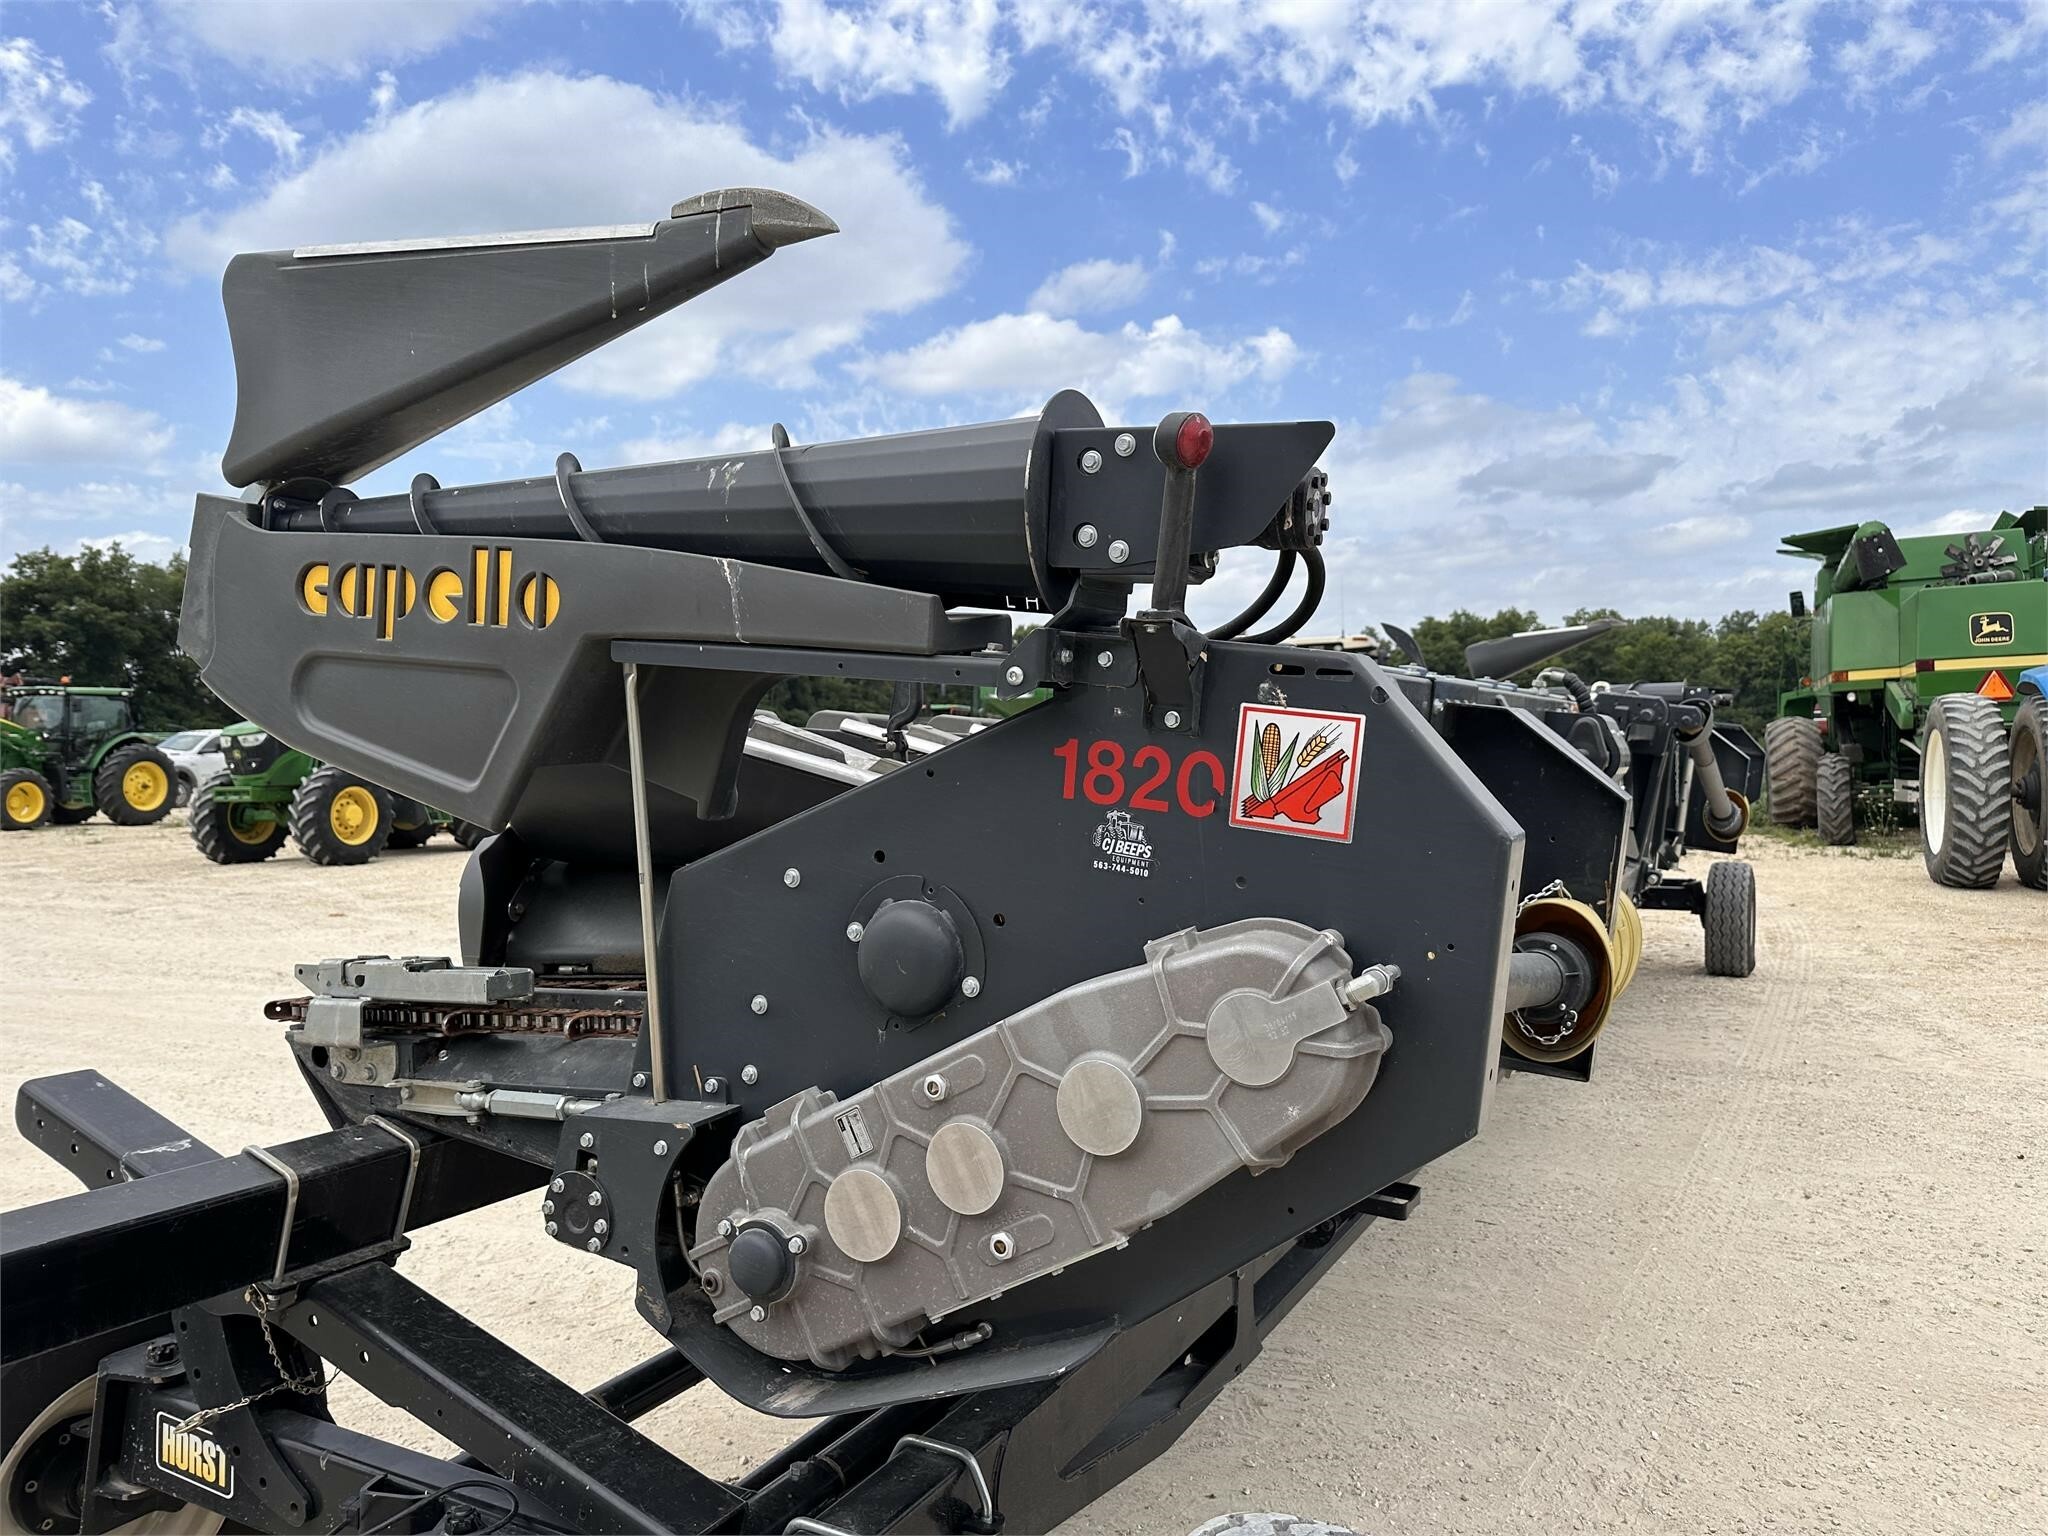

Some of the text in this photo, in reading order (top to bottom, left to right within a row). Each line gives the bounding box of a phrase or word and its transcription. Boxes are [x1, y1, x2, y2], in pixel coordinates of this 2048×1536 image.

[295, 544, 561, 642] capello
[1053, 738, 1226, 818] 1820
[1093, 860, 1149, 877] 563-744-5010
[1102, 838, 1153, 858] CJ BEEPS
[1112, 855, 1150, 868] EQUIPMENT
[162, 1422, 226, 1488] HORST
